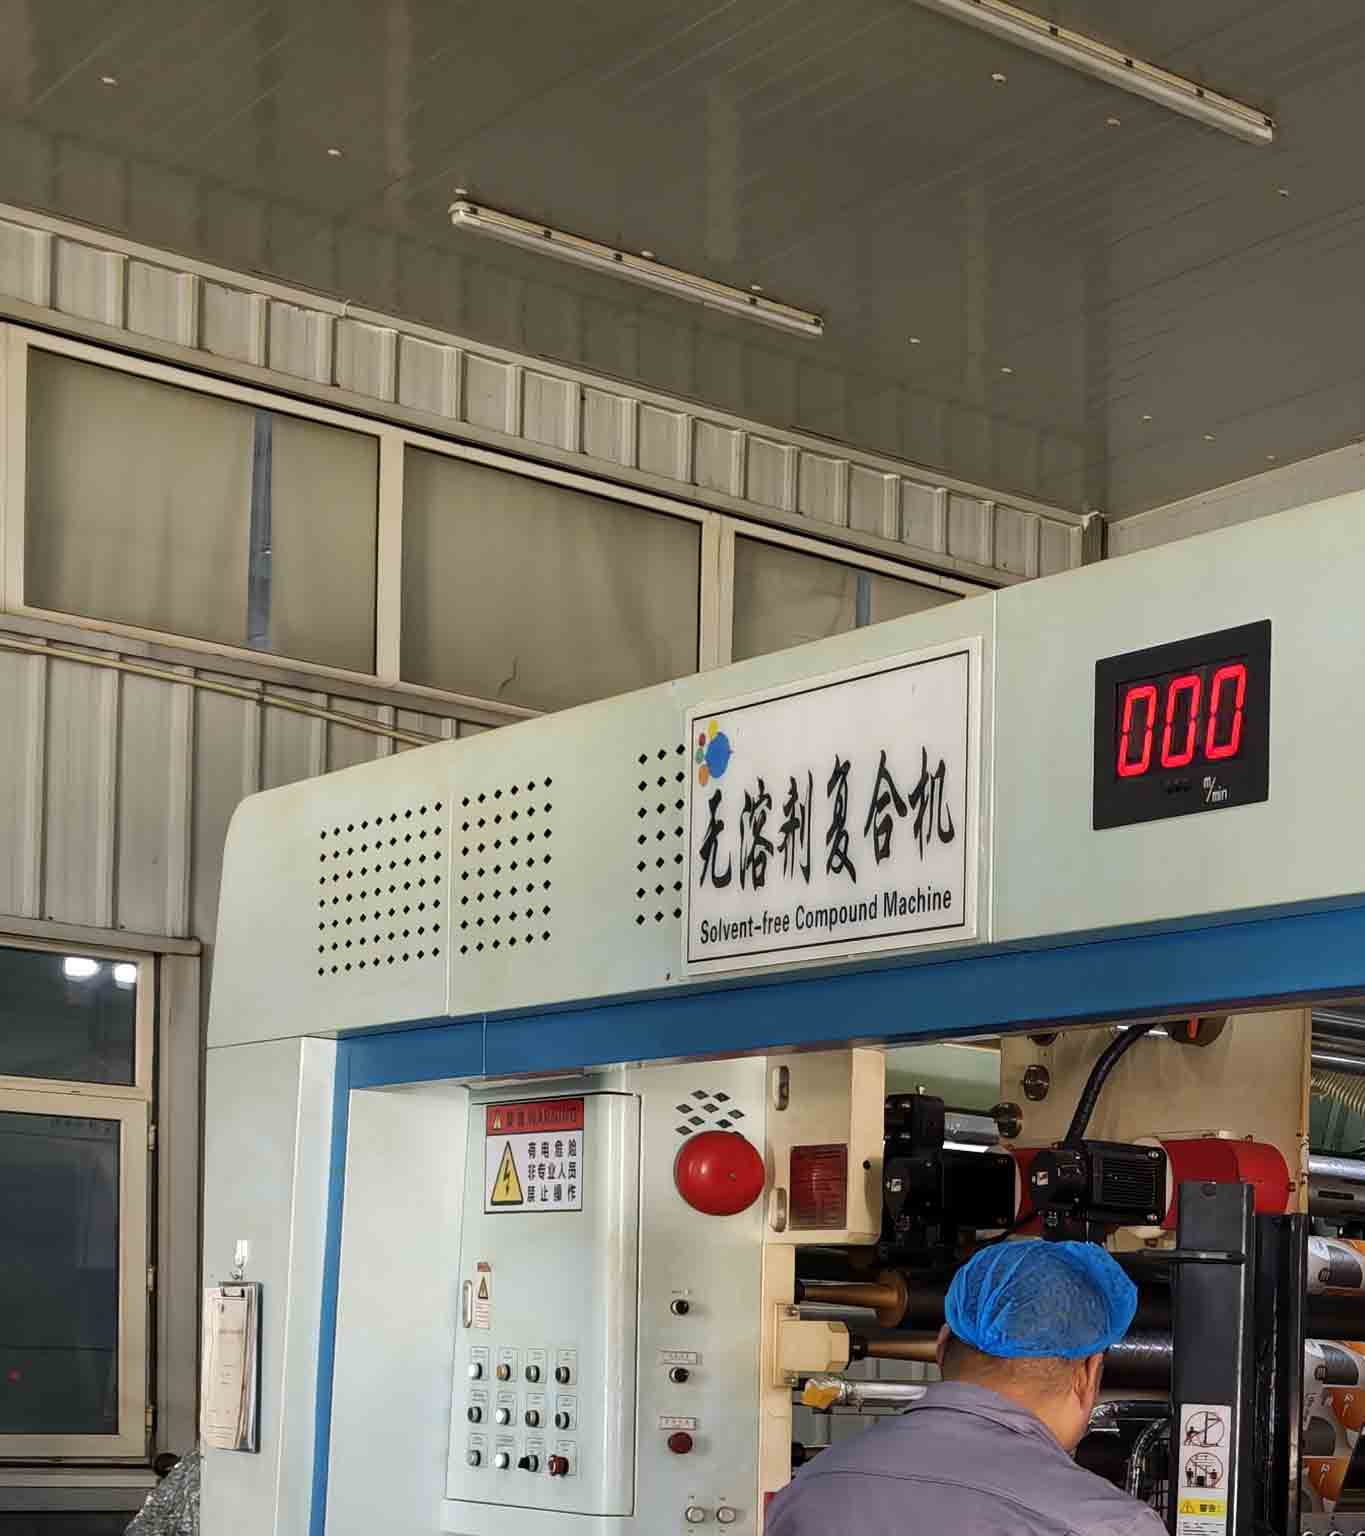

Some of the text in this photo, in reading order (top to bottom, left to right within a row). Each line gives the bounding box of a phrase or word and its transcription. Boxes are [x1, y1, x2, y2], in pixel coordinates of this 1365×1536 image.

[1117, 663, 1247, 776] 000
[699, 746, 955, 891] 无溶剂复合机
[700, 886, 952, 945] Solvent-free Compound Machine
